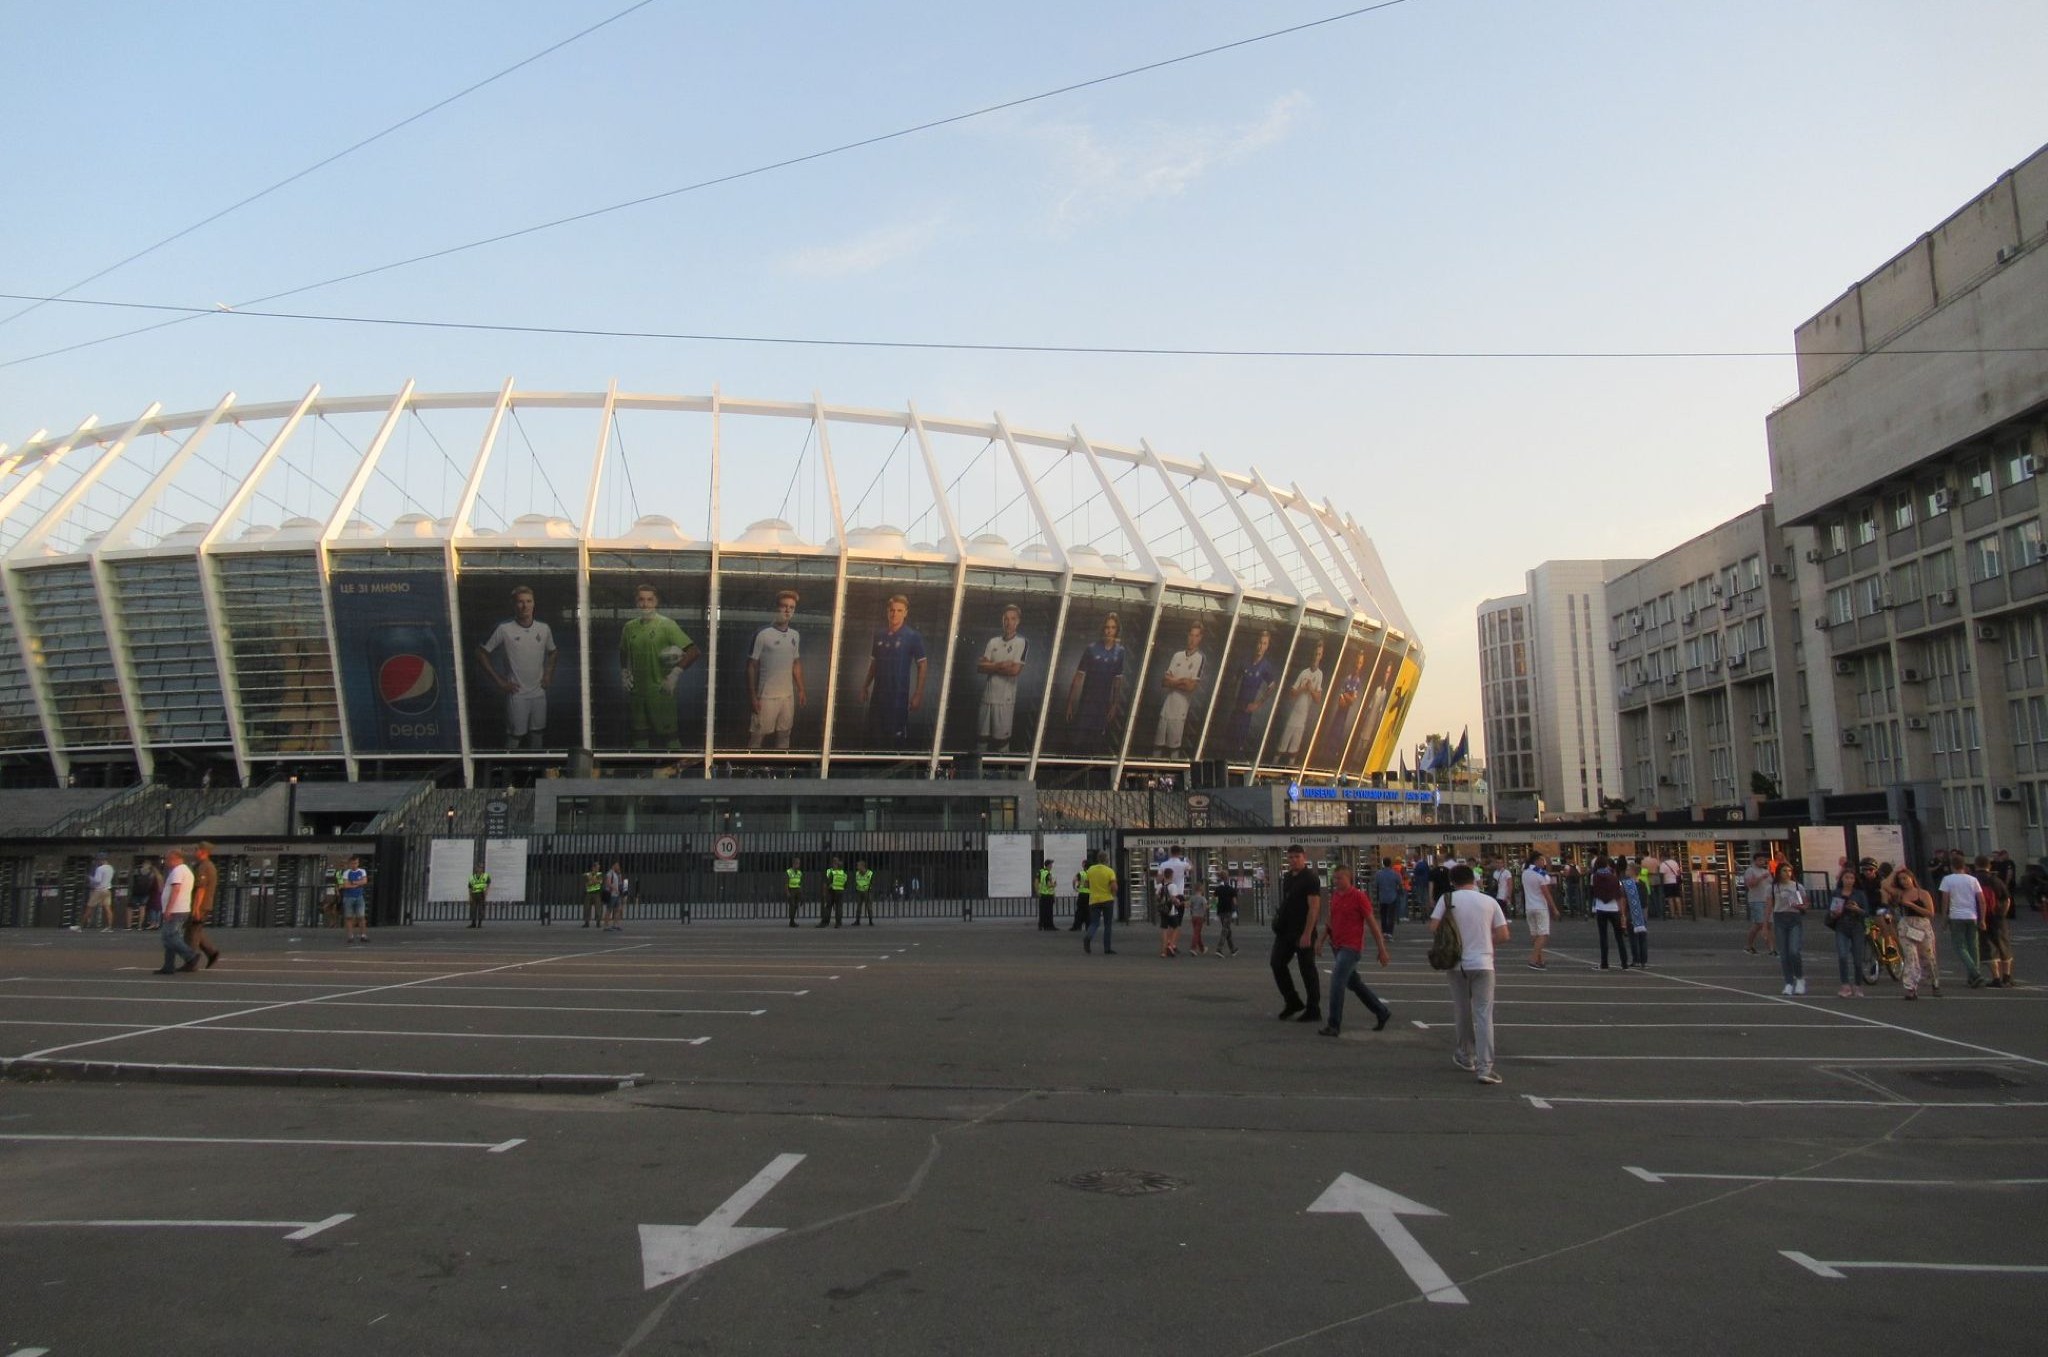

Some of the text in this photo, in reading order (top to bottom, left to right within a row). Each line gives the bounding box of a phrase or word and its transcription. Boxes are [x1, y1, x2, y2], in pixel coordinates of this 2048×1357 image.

[340, 583, 354, 593] ЦЕ
[371, 582, 410, 593] МНОЮ
[390, 720, 440, 740] pepsi
[1302, 788, 1337, 799] MUSEUM
[1223, 836, 1246, 844] North
[1290, 836, 1332, 844] Північний
[1443, 833, 1485, 841] Північний
[1137, 838, 1179, 846] Північний
[722, 842, 733, 852] 10
